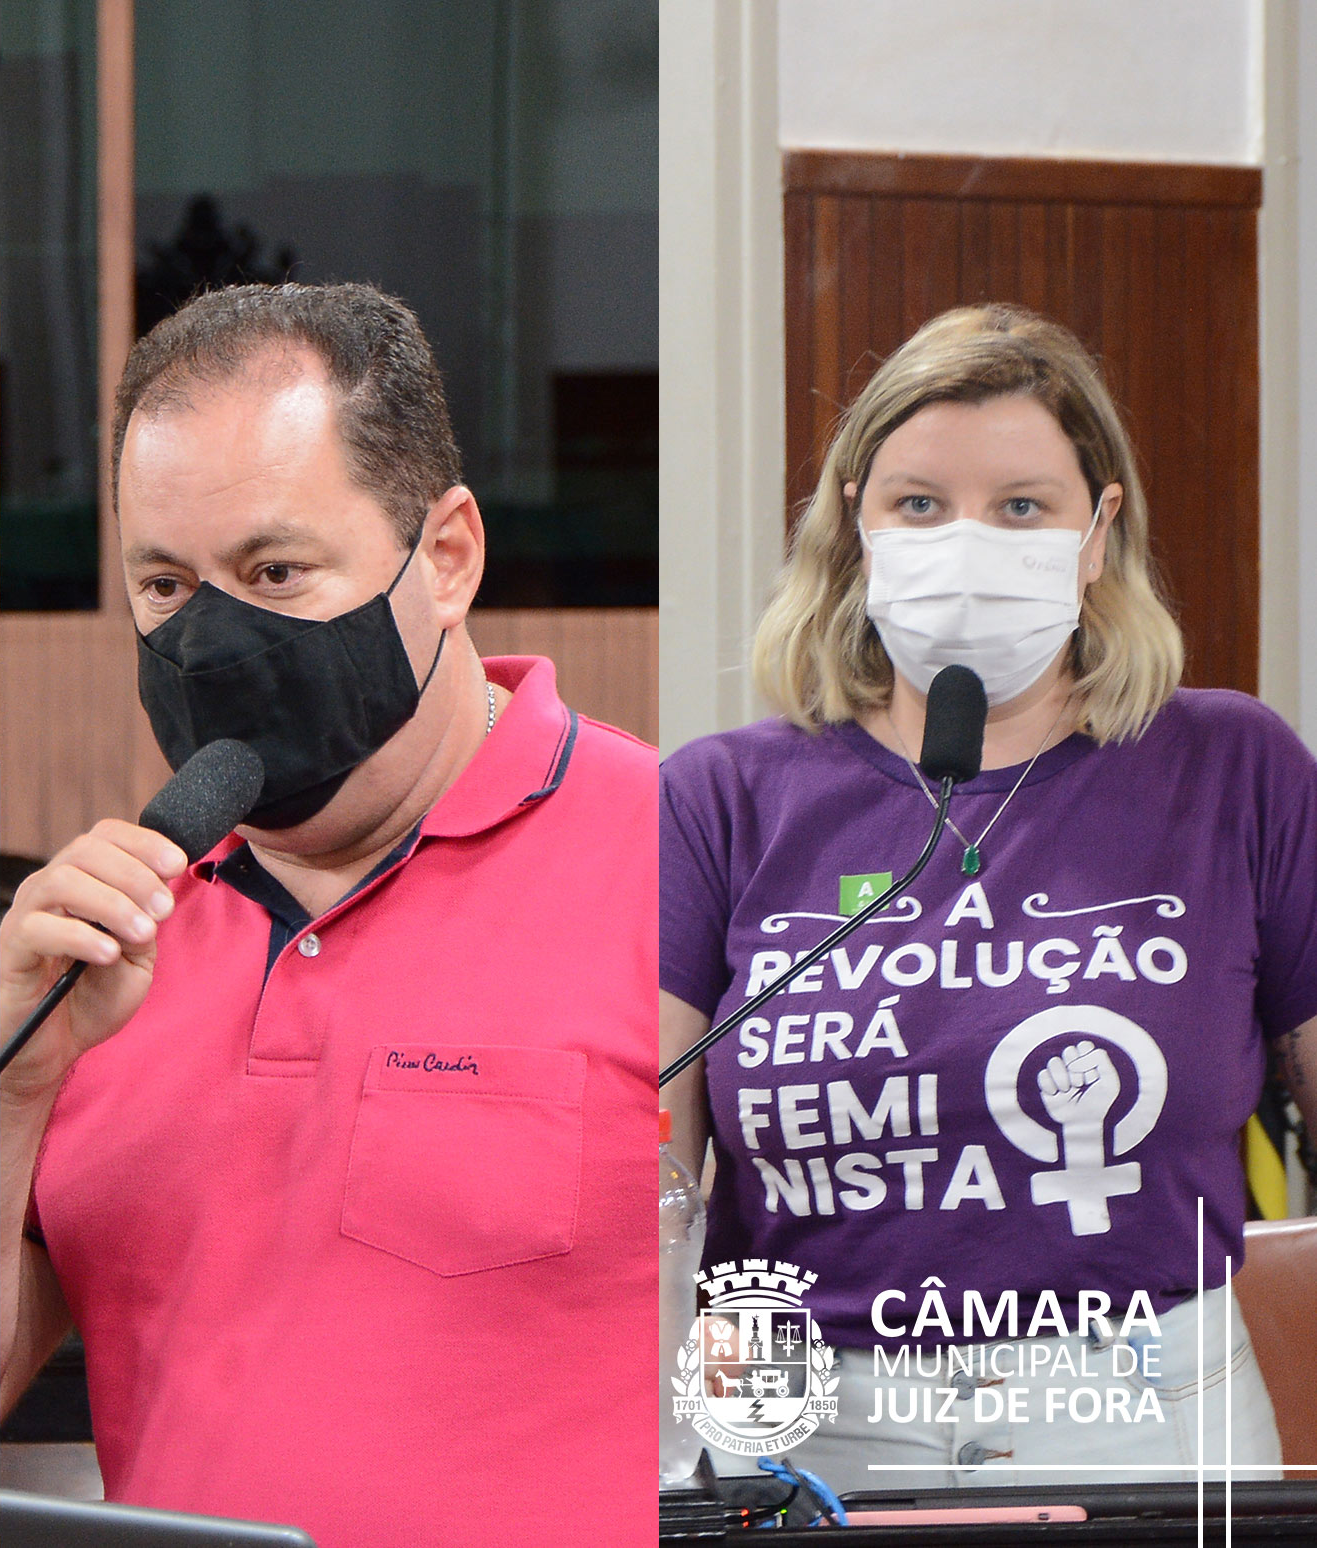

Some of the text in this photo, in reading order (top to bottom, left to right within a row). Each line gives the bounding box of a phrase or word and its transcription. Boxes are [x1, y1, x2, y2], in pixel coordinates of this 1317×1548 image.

[945, 882, 994, 930] A
[745, 925, 1188, 998] REVOLUÇÃO
[738, 995, 909, 1069] SERÁ
[738, 1074, 940, 1150] FEMI
[752, 1145, 1006, 1217] NISTA
